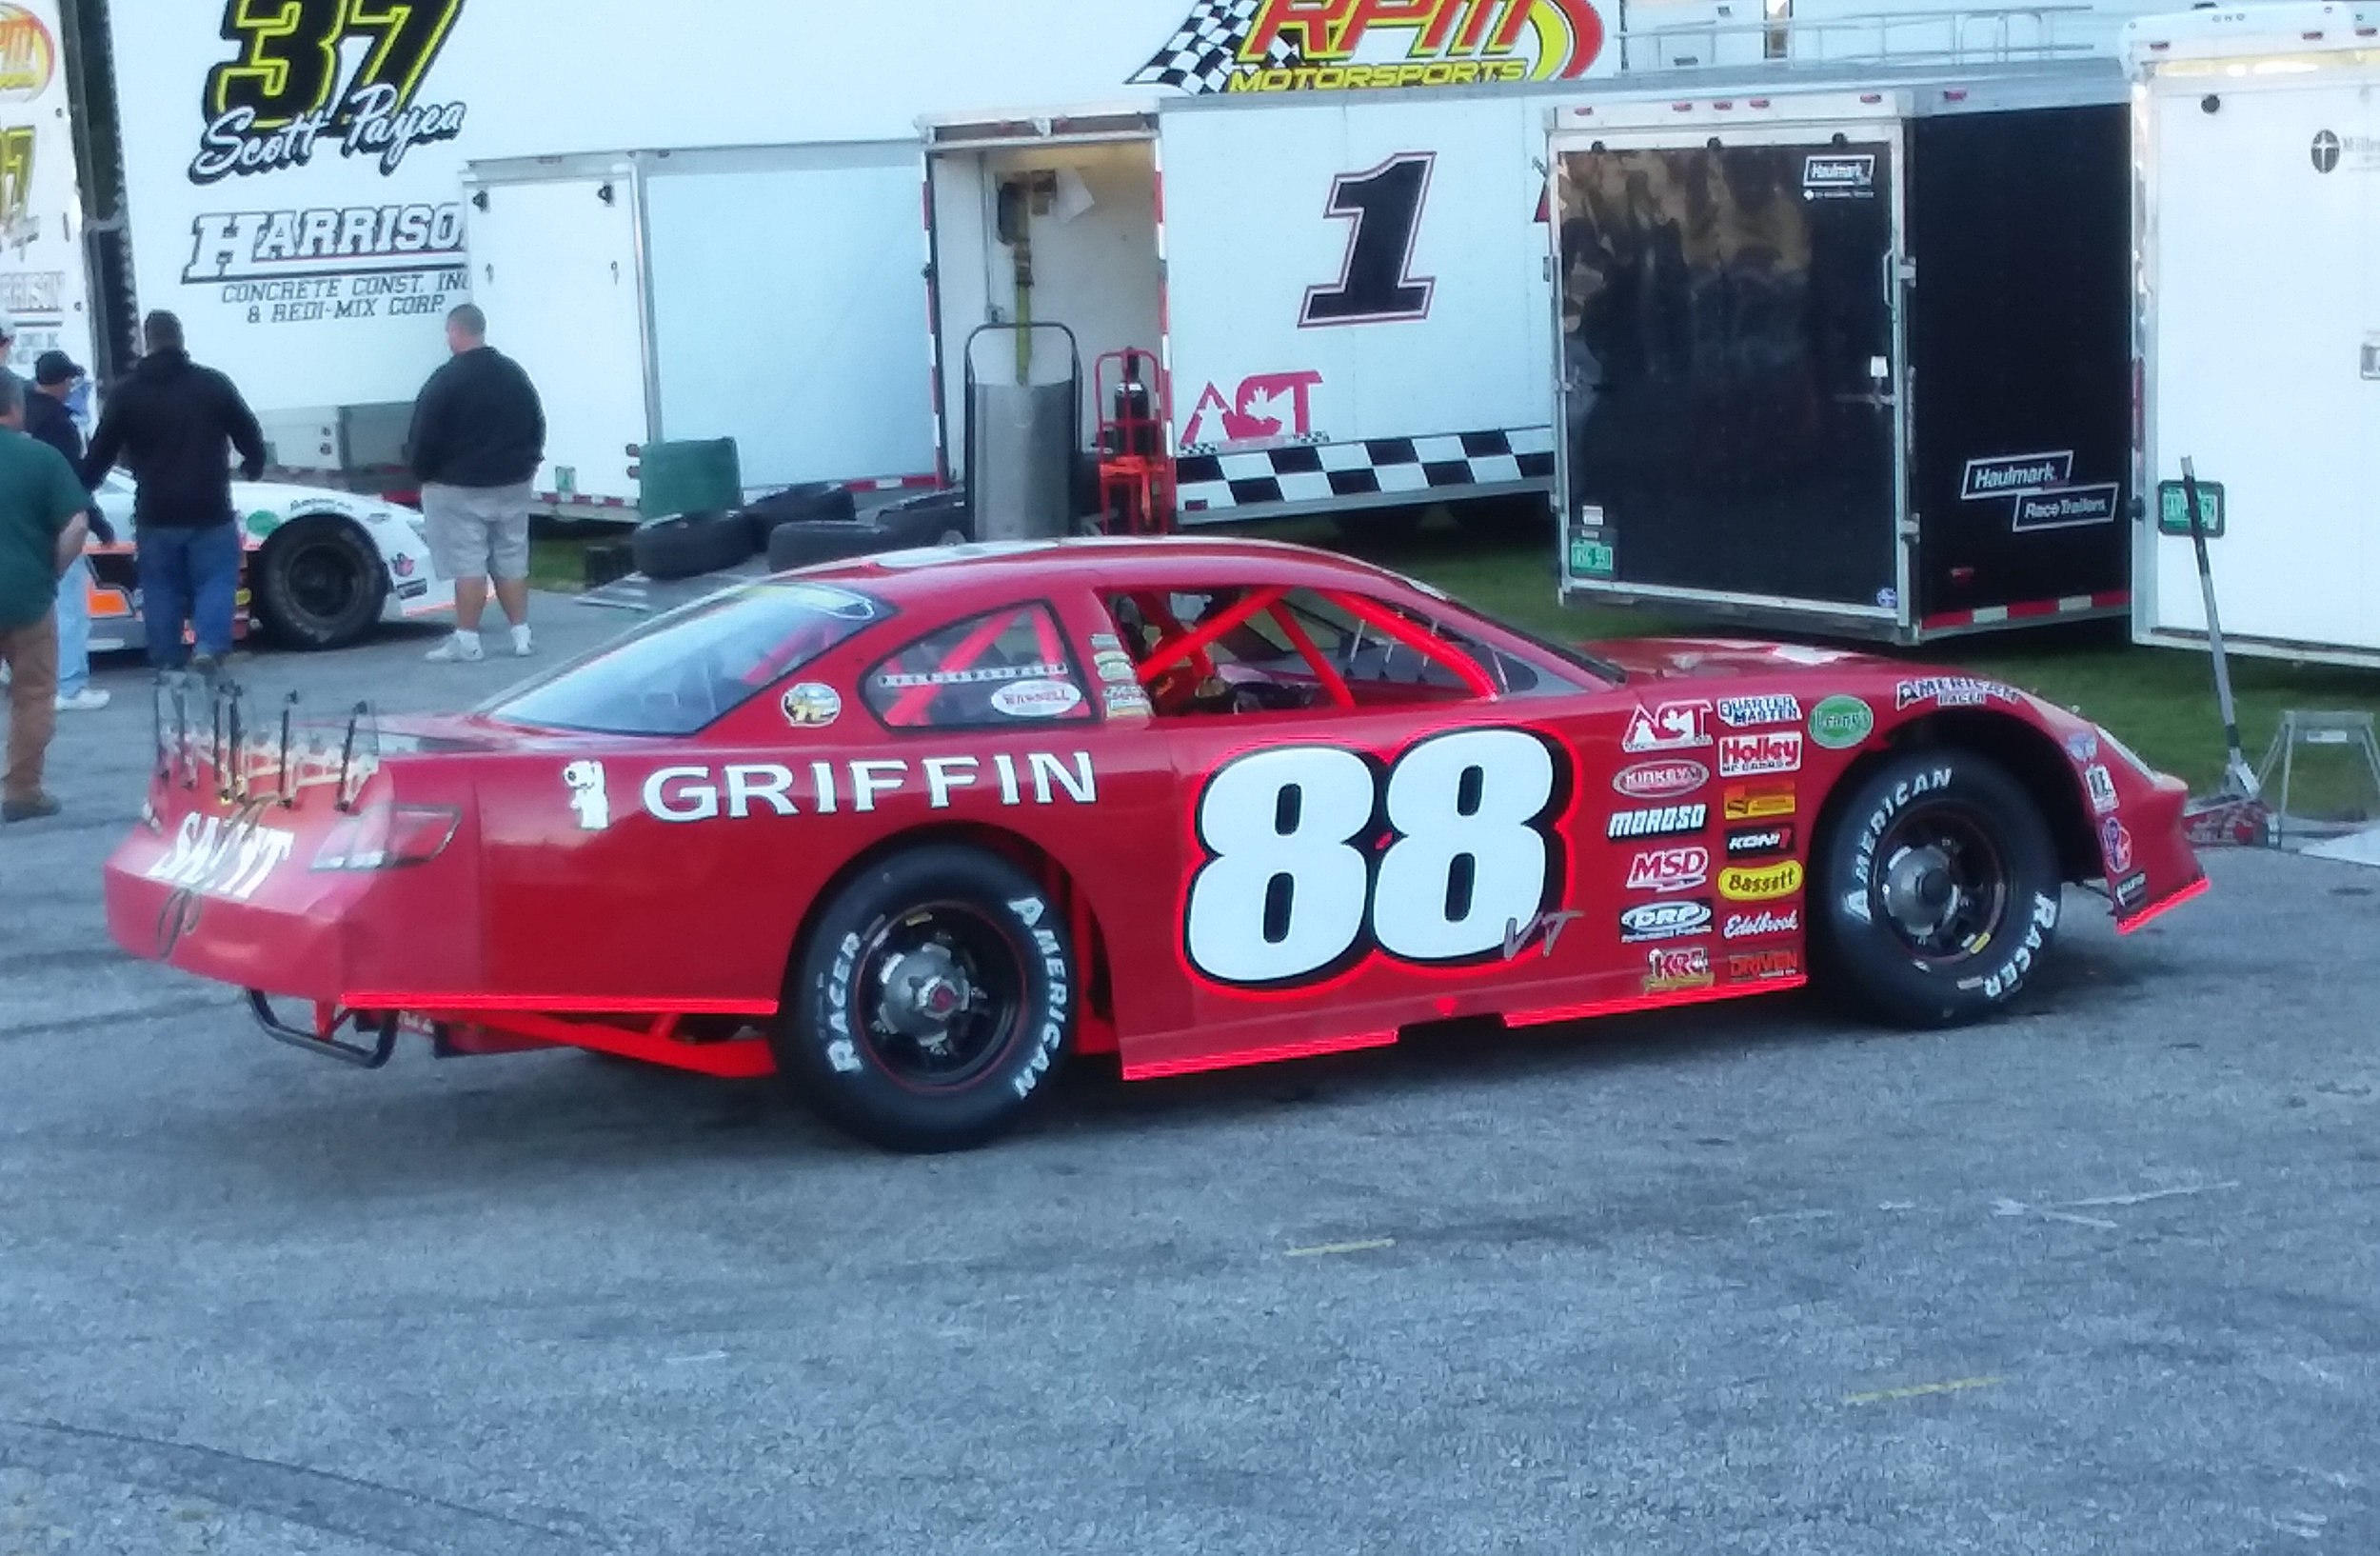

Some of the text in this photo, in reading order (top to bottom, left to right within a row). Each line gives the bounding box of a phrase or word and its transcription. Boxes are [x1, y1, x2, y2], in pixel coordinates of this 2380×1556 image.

[202, 0, 466, 135] 37
[1230, 59, 1527, 92] MOTORSPORTS
[188, 83, 466, 184] Scott Payea
[1298, 152, 1437, 329] 1
[222, 278, 342, 304] CONCRETE
[352, 273, 424, 296] CONST.
[247, 294, 446, 324] & REDI-MIX CORP.
[1974, 461, 2055, 489] Haulmark
[2025, 503, 2060, 518] Race
[1722, 737, 1798, 767] Holley
[643, 750, 1097, 822] GRIFFIN
[1608, 804, 1706, 838] MOROSO
[1185, 728, 1566, 983] 88
[1631, 848, 1708, 882] MSD
[1729, 868, 1795, 893] Bassett
[1843, 768, 2056, 999] AMERICAN RACER
[1635, 905, 1699, 929] DRP
[1724, 909, 1798, 939] Edelbrock
[1504, 911, 1584, 961] VT
[1730, 953, 1797, 977] DRIVEN
[827, 896, 1067, 1100] RACER AMERICAN
